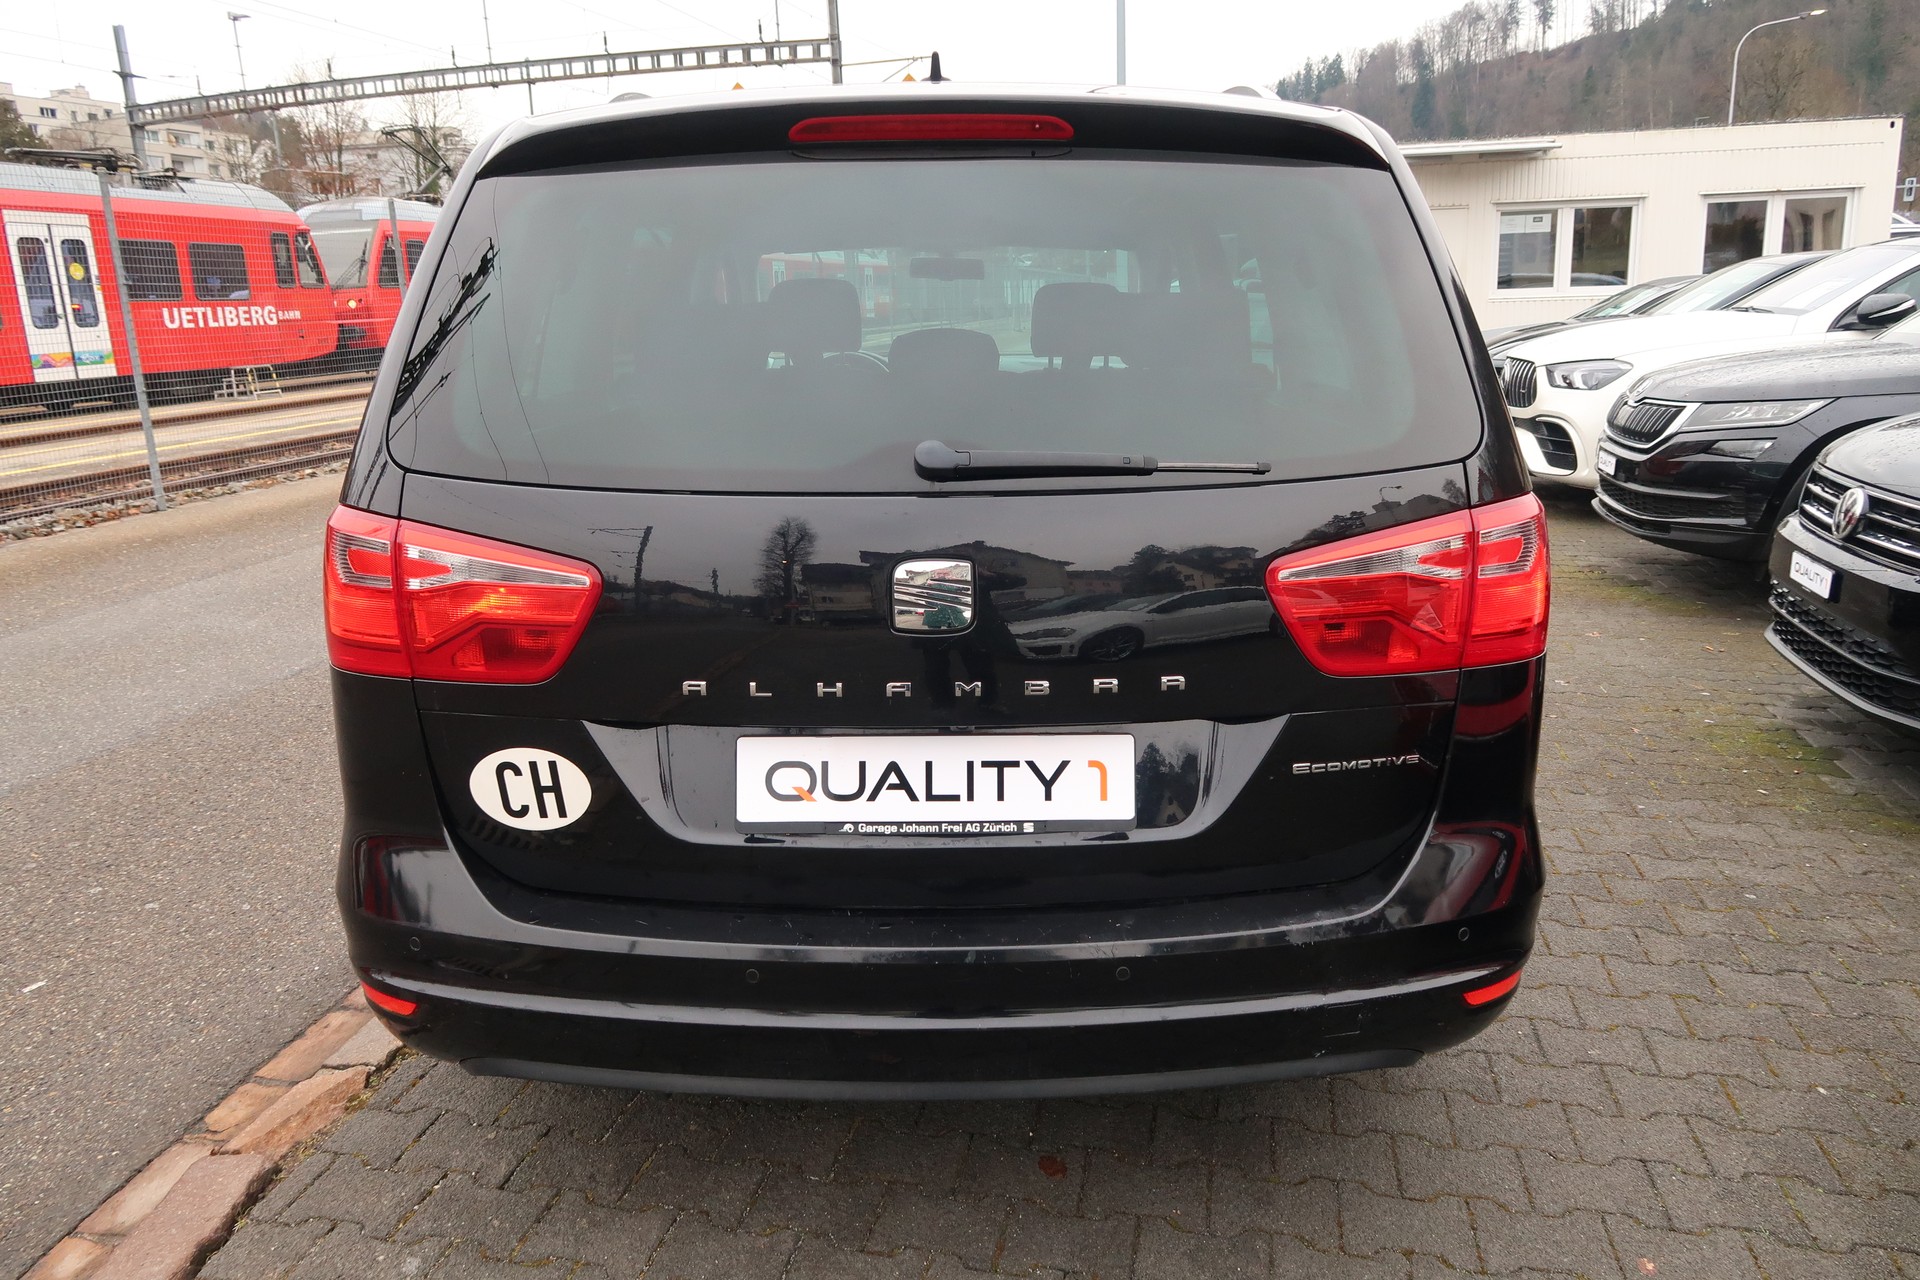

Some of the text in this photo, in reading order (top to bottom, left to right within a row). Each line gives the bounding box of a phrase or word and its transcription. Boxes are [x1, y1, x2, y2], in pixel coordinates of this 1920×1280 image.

[162, 305, 302, 329] UETLIBERG BAHN
[1794, 561, 1825, 587] QUALITY
[682, 675, 1186, 698] ALHAMBRA
[495, 760, 568, 819] CH
[765, 760, 1108, 802] QUALITY 1
[858, 821, 1018, 835] Garage Johann Frei AG Zürich
